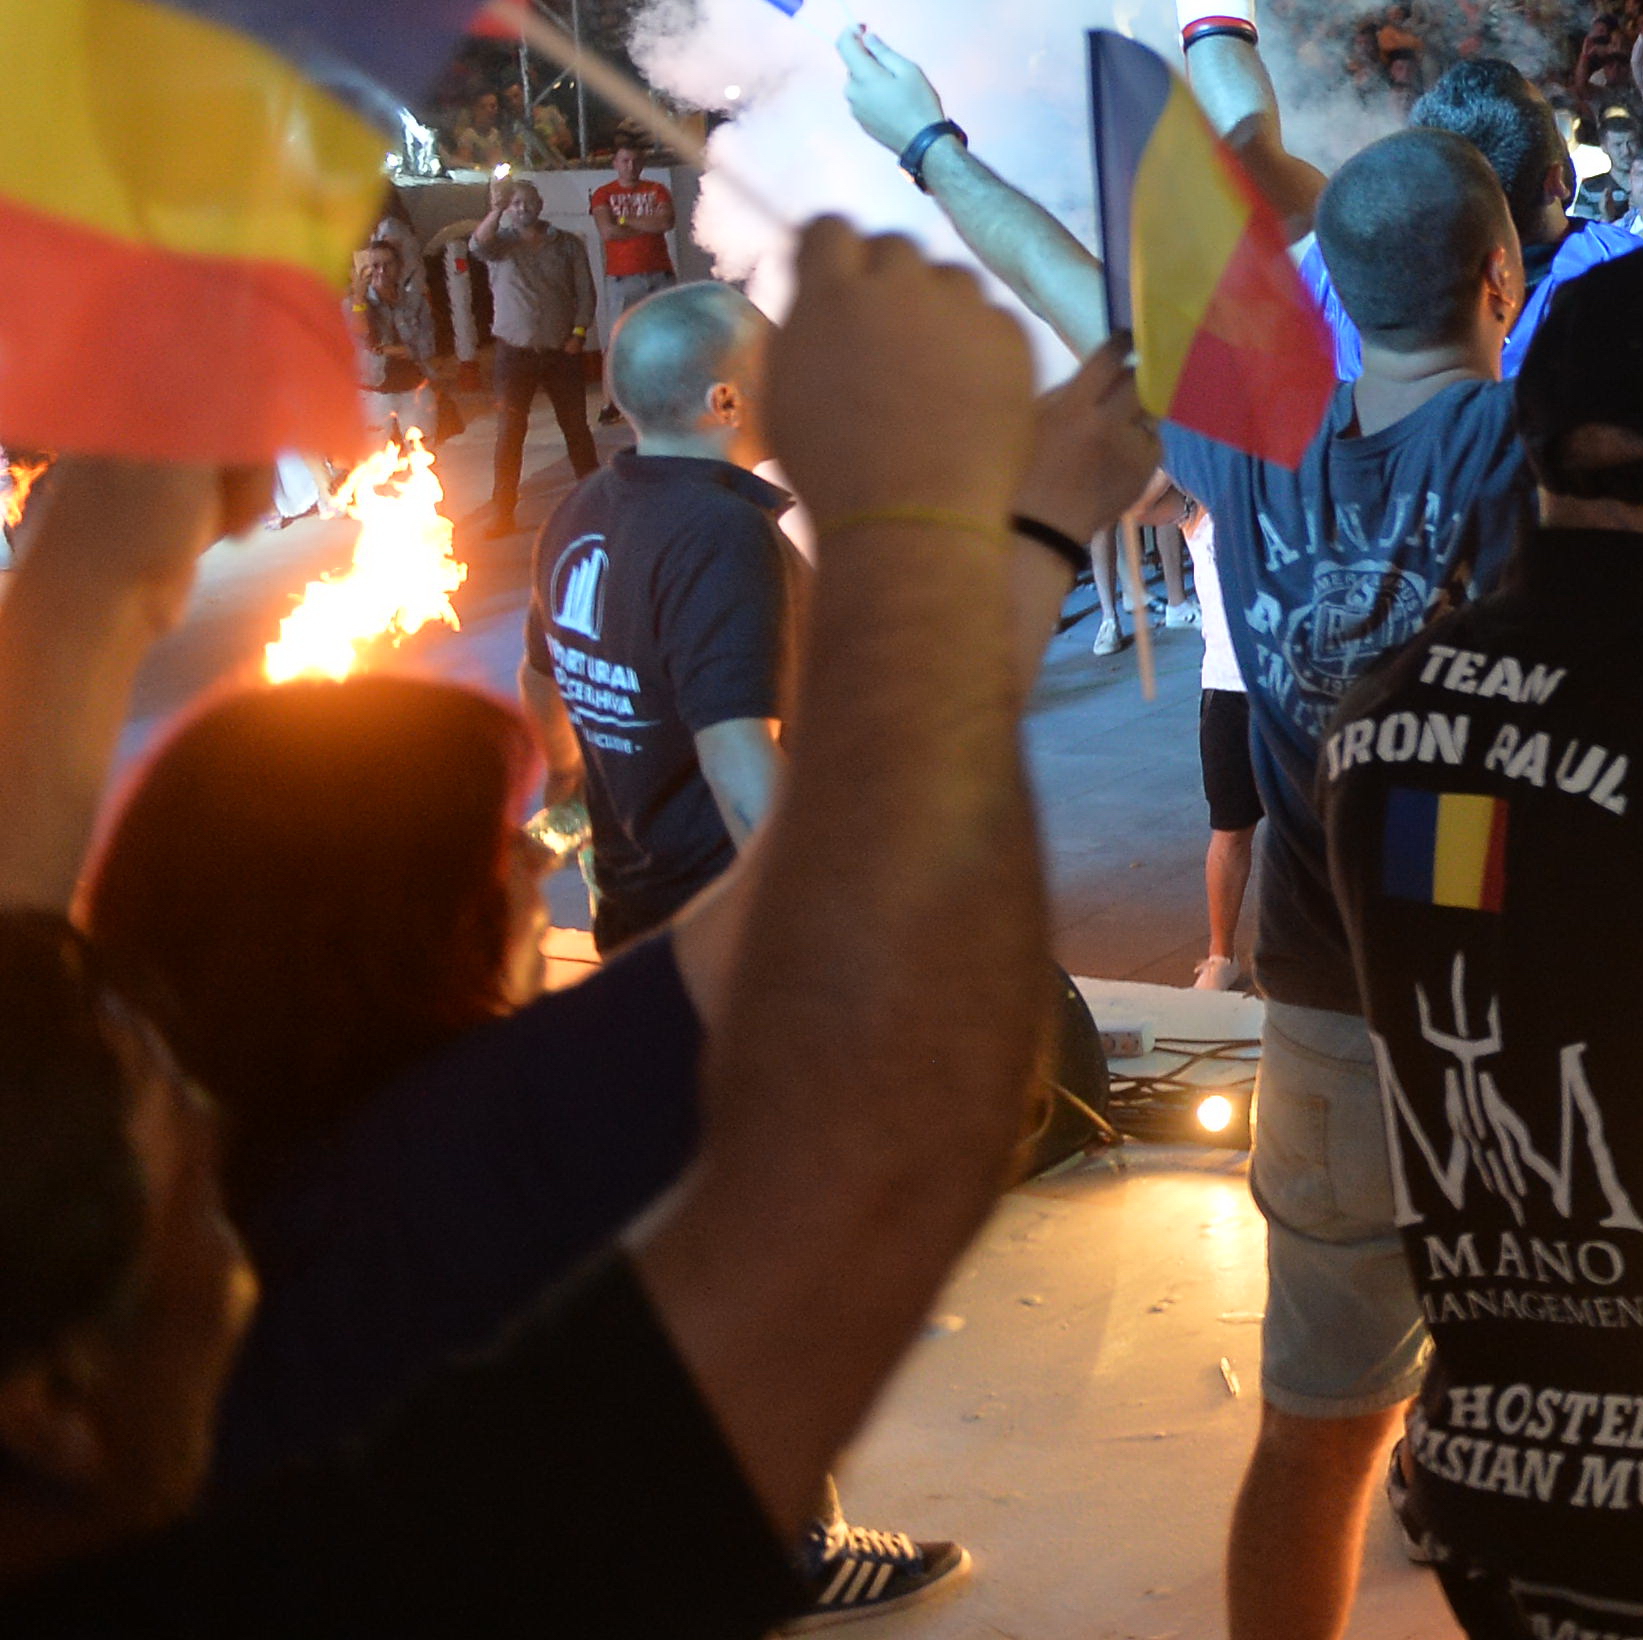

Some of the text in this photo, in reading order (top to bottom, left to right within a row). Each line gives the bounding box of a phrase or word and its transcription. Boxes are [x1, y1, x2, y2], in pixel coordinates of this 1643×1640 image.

[1420, 645, 1567, 705] TEAM
[1484, 723, 1628, 815] PAUL
[1424, 1231, 1626, 1286] MANO
